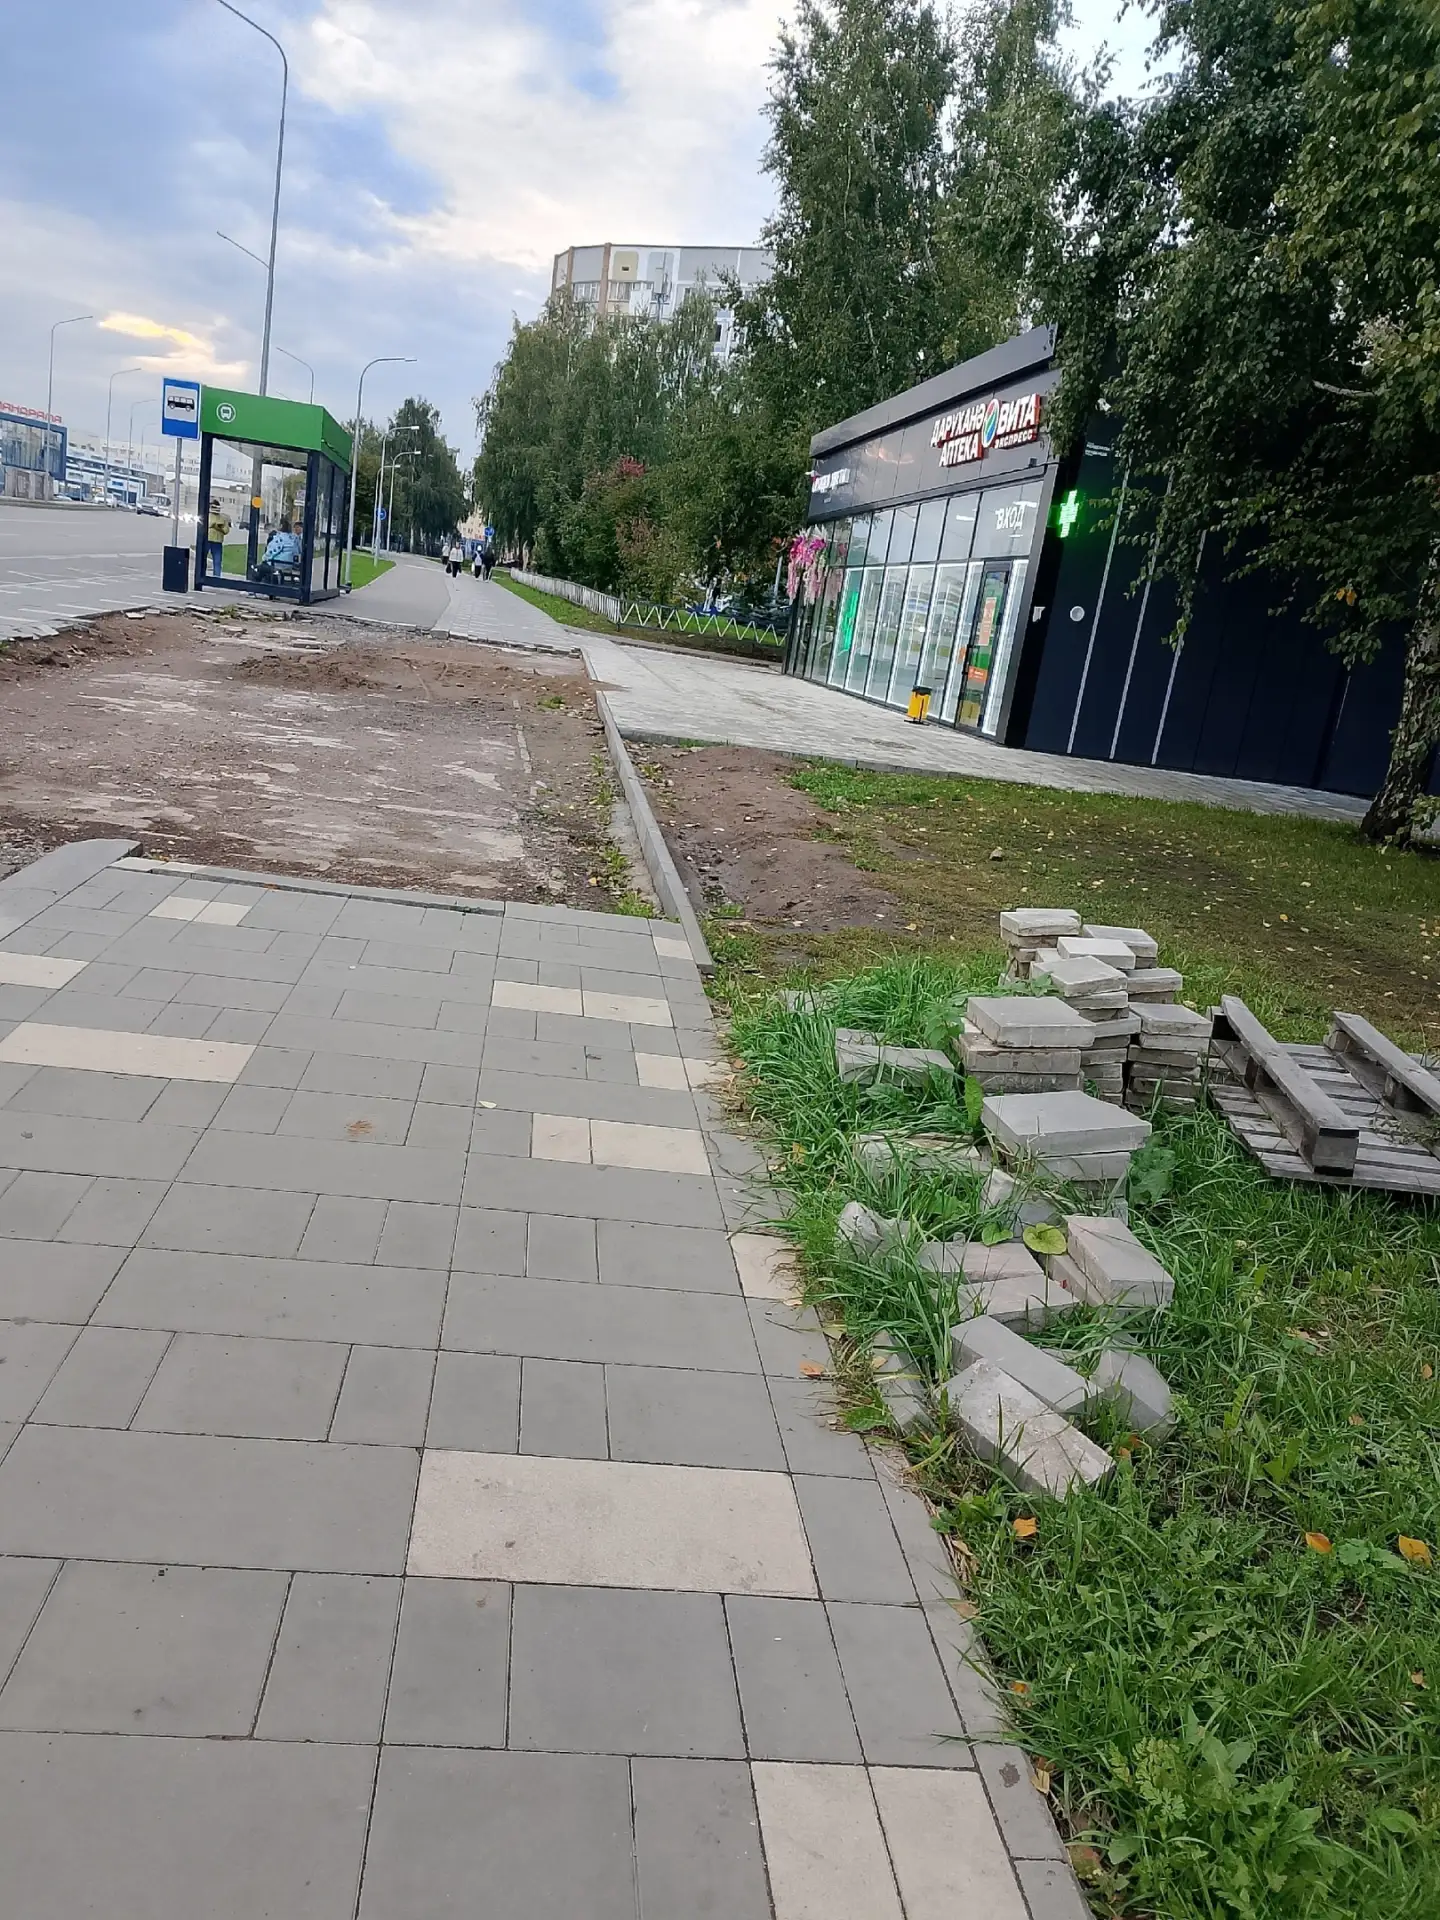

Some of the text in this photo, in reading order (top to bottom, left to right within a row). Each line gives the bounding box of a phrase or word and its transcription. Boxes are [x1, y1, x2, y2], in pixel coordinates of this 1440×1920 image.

[0, 401, 62, 423] АНОРАМА
[930, 393, 1038, 447] ДАРУХАНӘ ВИТА
[939, 432, 979, 467] АПТЕКА
[994, 428, 1033, 449] ЭКСПРЕСС
[996, 505, 1025, 531] ВХОД
